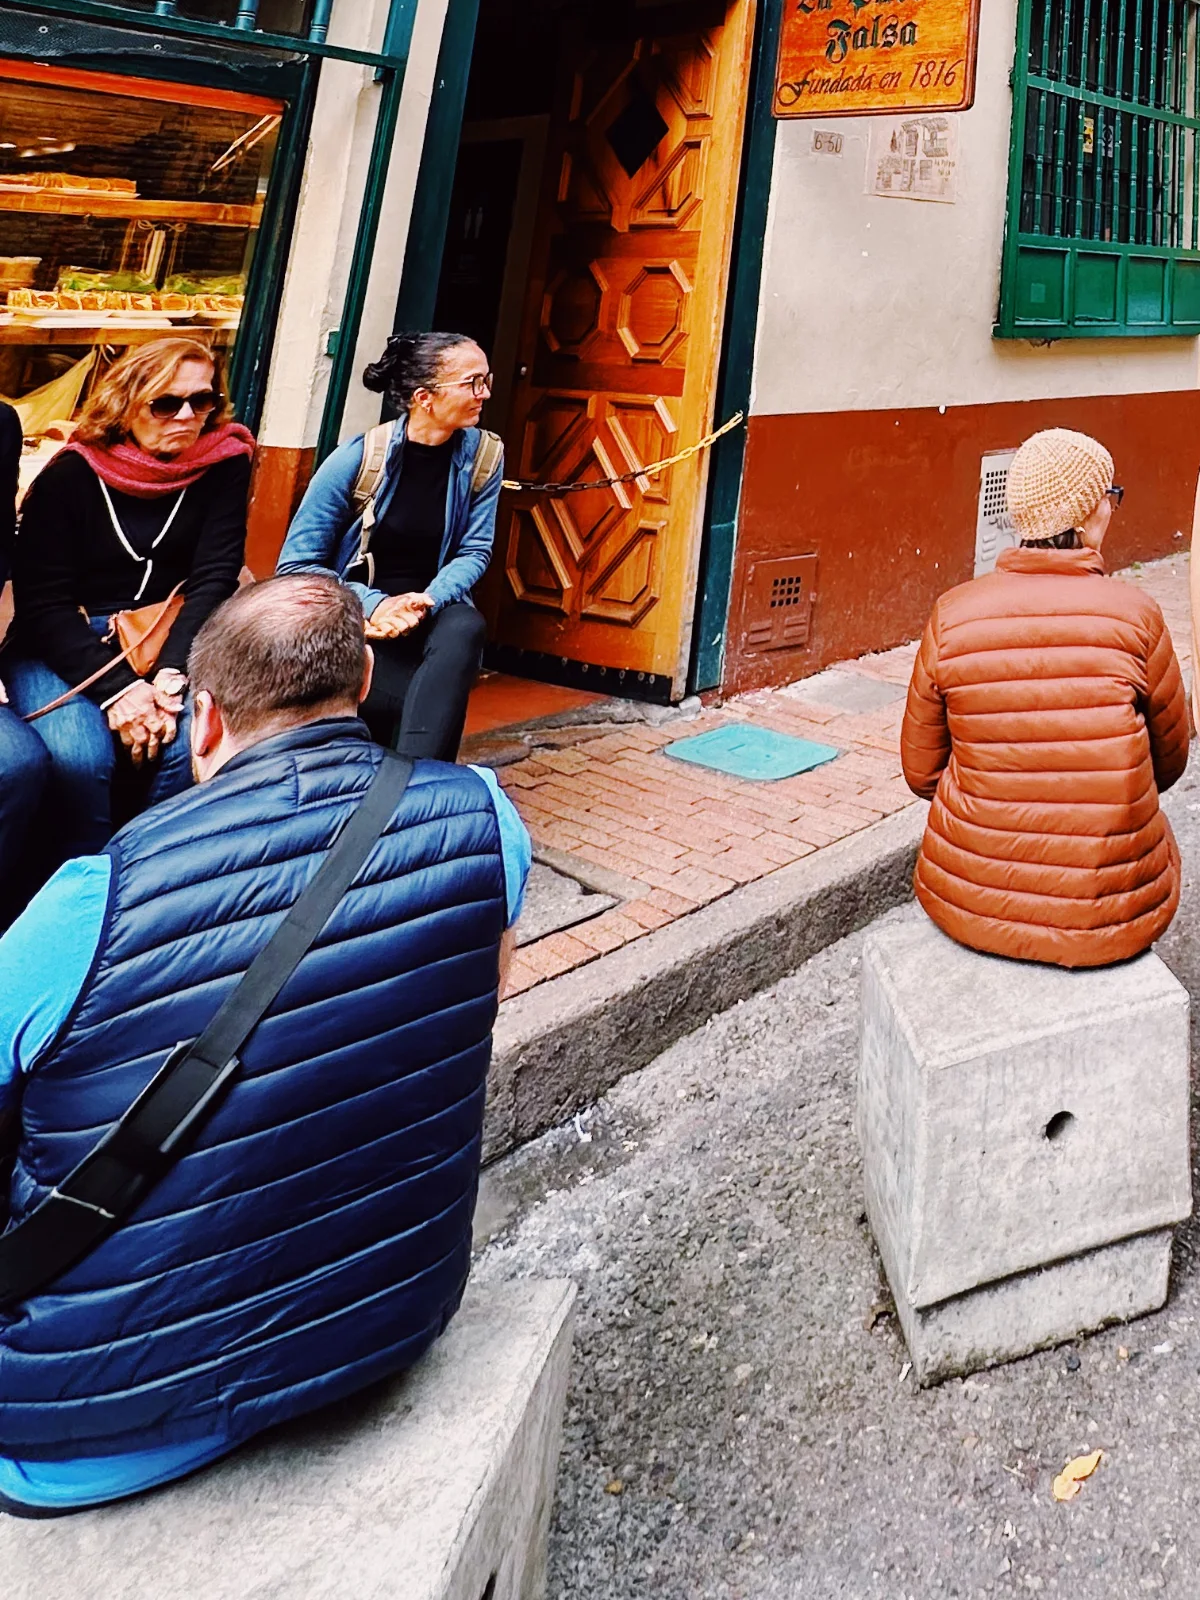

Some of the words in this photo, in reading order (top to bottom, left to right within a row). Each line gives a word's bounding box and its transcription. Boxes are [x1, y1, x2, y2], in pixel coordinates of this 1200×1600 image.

[825, 14, 918, 64] Falsa
[879, 73, 902, 89] en
[911, 59, 964, 88] 1816
